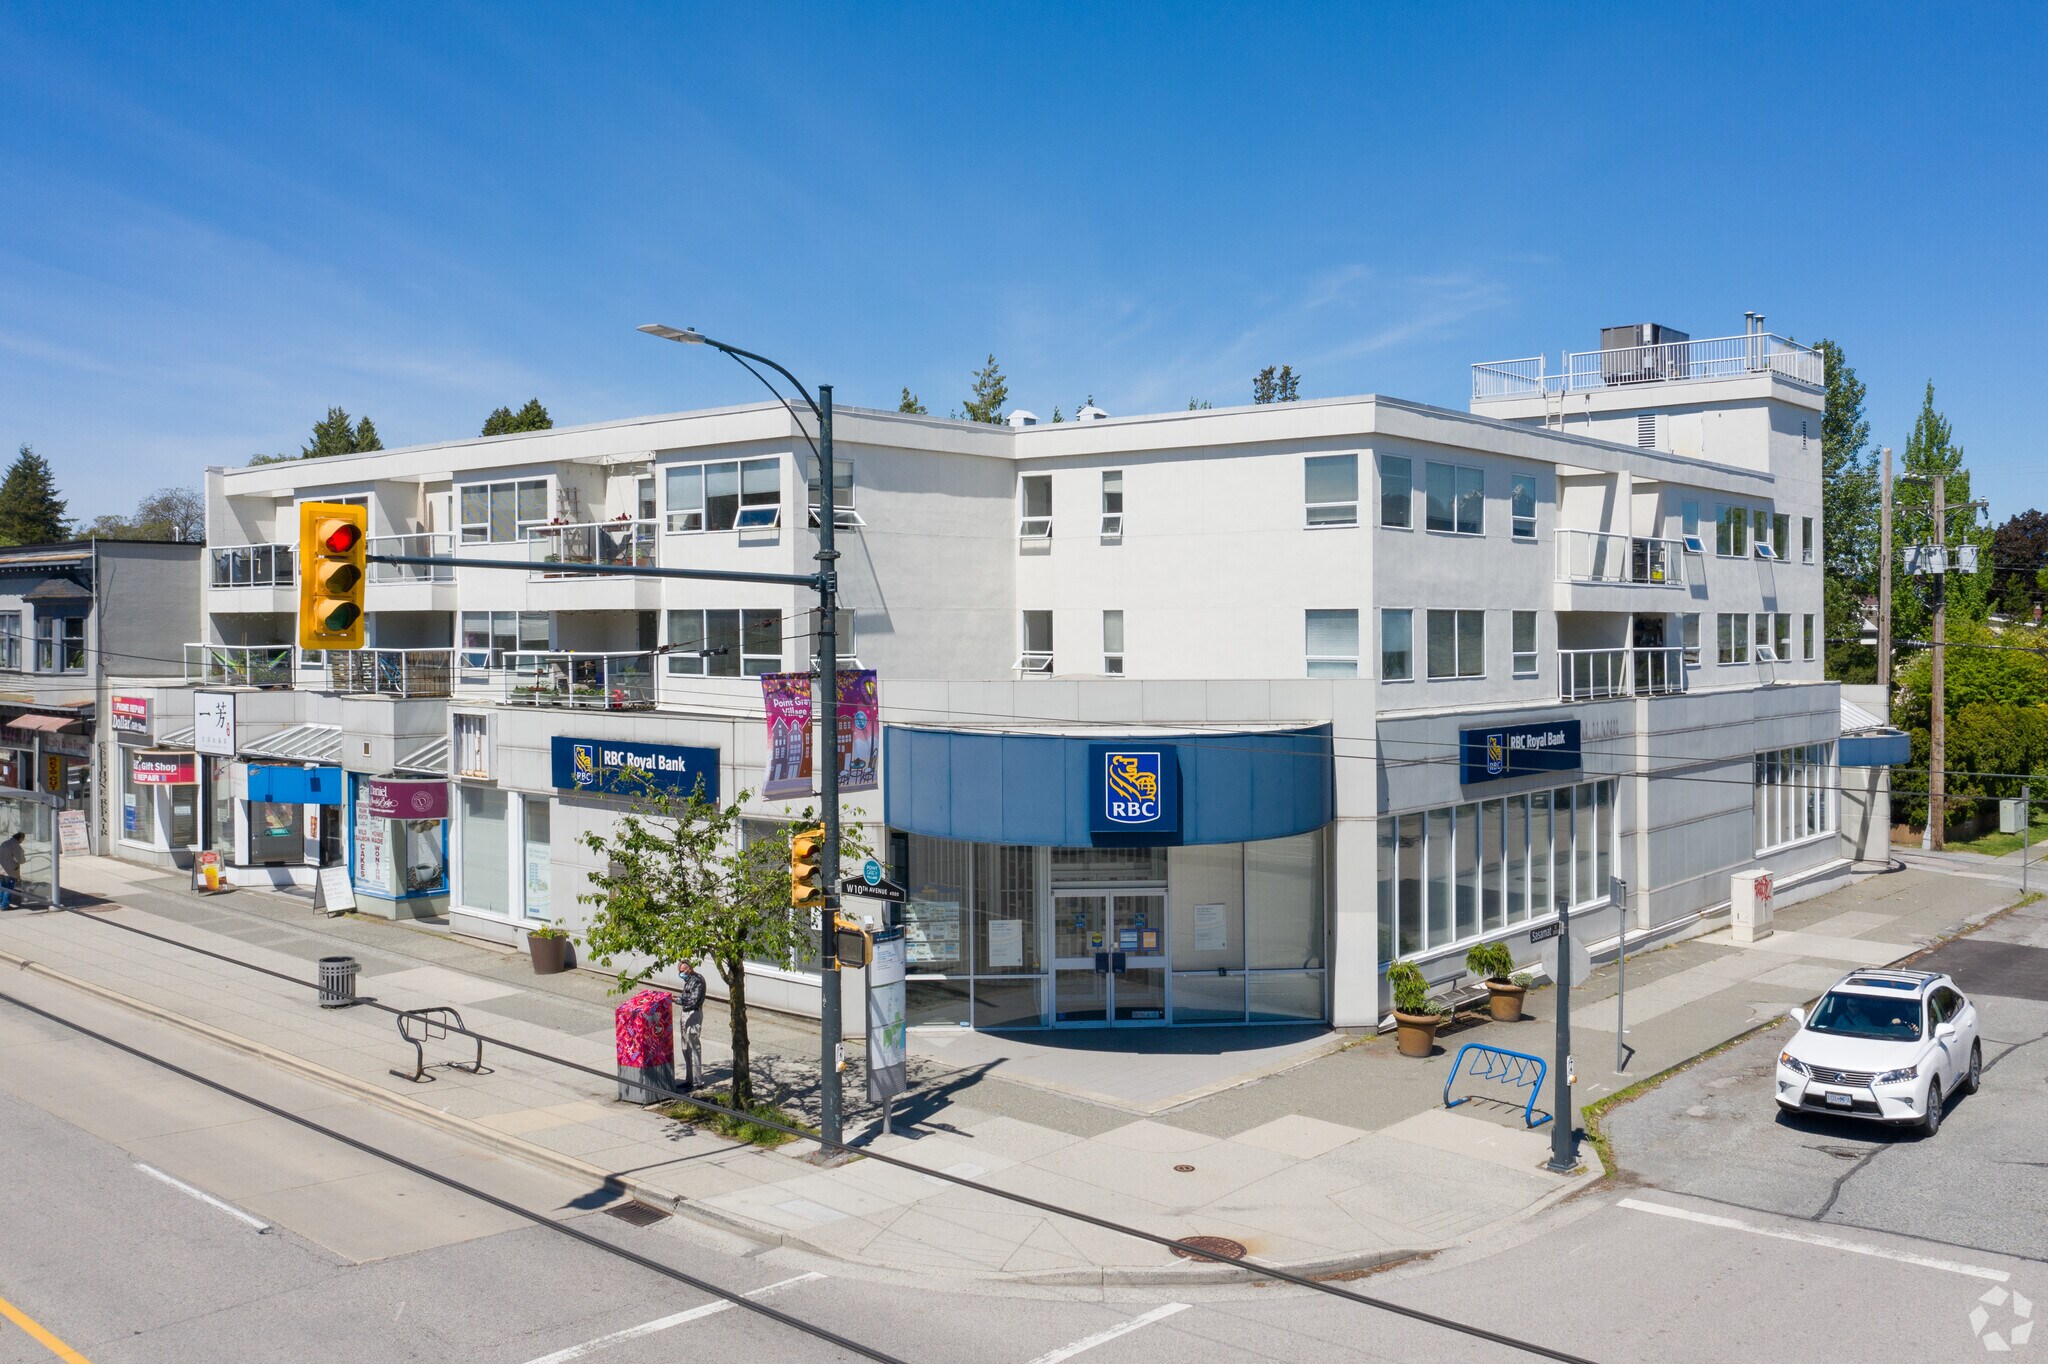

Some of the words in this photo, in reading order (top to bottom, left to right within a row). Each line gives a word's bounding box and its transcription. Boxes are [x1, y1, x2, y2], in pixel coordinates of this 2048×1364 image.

[773, 698, 794, 708] Point
[794, 696, 811, 708] Grey
[129, 704, 145, 715] REPAIR
[199, 701, 227, 728] 一芳
[782, 707, 808, 719] Village
[112, 714, 131, 730] Dollar
[1510, 734, 1526, 750] RBC
[1526, 732, 1547, 750] Royal
[1547, 730, 1566, 746] Bank
[141, 761, 154, 771] Gift
[154, 762, 177, 773] Shop
[604, 750, 624, 766] RBC
[626, 752, 656, 772] Royal
[658, 755, 686, 772] Bank
[1489, 762, 1501, 771] RBC
[137, 773, 160, 782] REPAIR
[576, 771, 591, 782] RBC
[49, 776, 58, 790] CUT
[370, 785, 388, 798] Daniel
[1112, 802, 1155, 817] RBC
[371, 837, 384, 845] MADE
[868, 886, 888, 896] AVENUE
[1532, 926, 1552, 941] Sasamat
